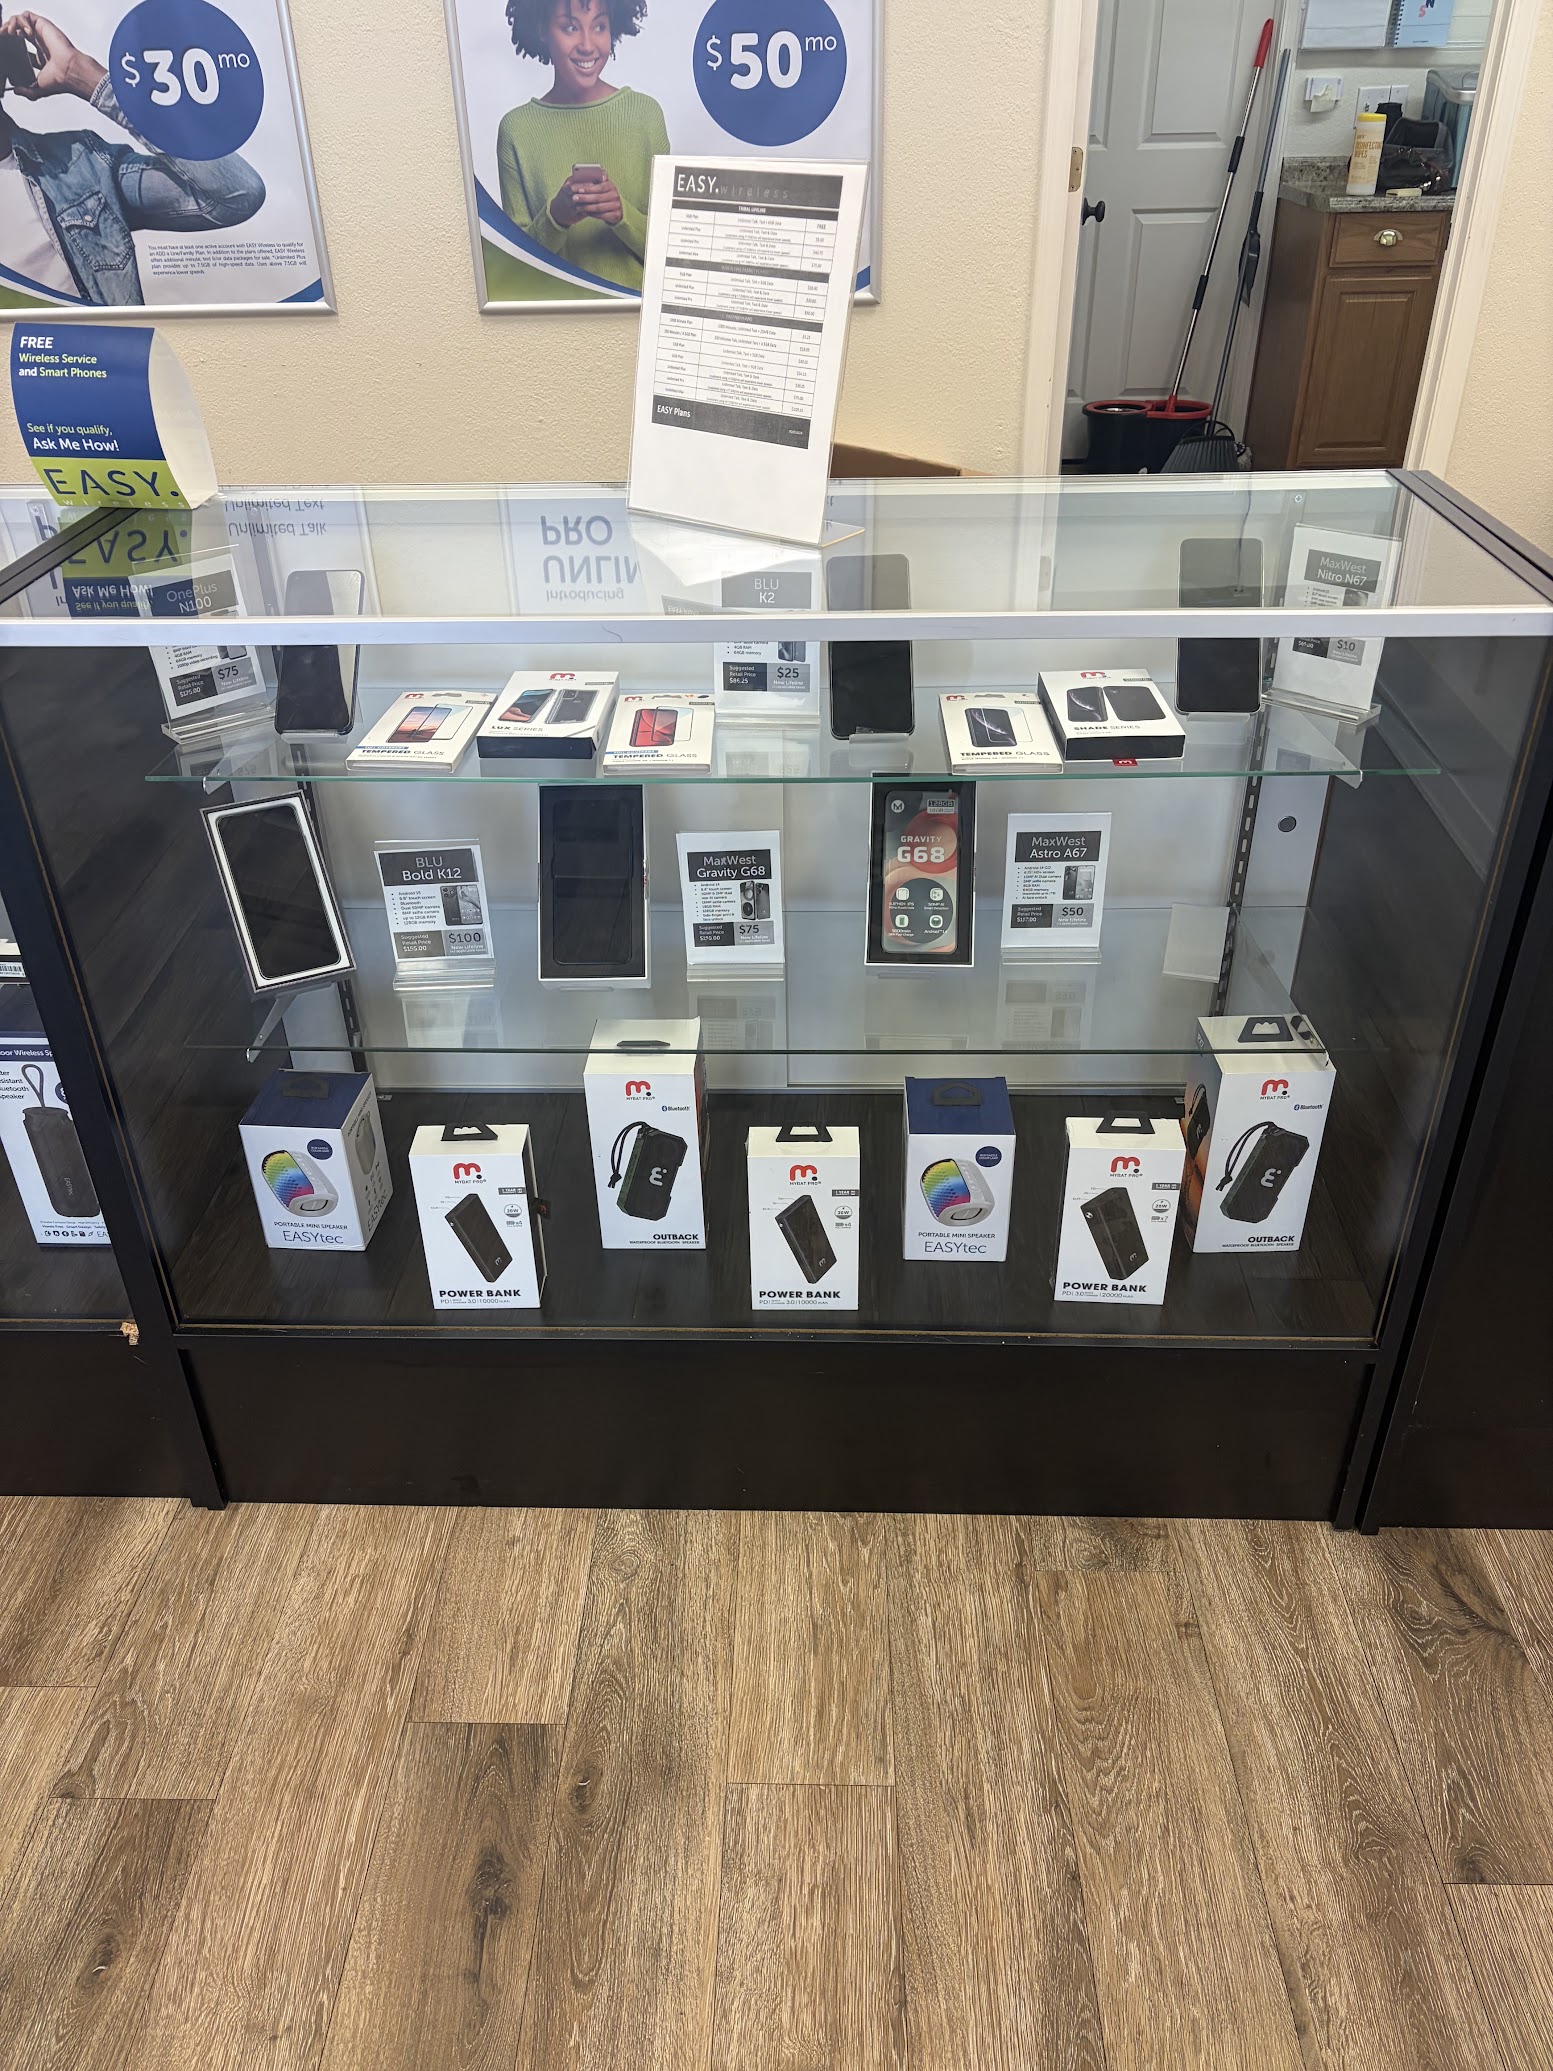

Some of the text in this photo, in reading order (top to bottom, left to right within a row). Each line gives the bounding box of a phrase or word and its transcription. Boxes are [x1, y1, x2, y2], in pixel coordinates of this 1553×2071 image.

[20, 336, 53, 348] FREE
[19, 353, 97, 364] Wireless Service
[19, 368, 107, 378] and Smart Phones
[657, 404, 691, 418] EASY Plans
[27, 423, 112, 435] See if you qualify,
[33, 438, 120, 451] Ask Me How!
[44, 469, 179, 497] EASY.
[1320, 556, 1367, 573] MaxWest
[1318, 569, 1367, 585] Nitro N67
[754, 578, 779, 590] BLU
[167, 582, 217, 602] OnePlus
[759, 593, 775, 603] K2
[178, 596, 212, 614] N100
[1337, 639, 1355, 651] $10
[218, 666, 238, 680] $75
[777, 666, 799, 679] $25
[1032, 837, 1085, 846] MaxWest
[897, 847, 945, 863] G68
[1030, 848, 1087, 858] Astro A67
[416, 857, 443, 868] BLU
[704, 856, 756, 866] MaxWest
[403, 868, 462, 881] Bold K12
[697, 867, 765, 879] Gravity G68
[1062, 907, 1083, 916] $50
[739, 924, 759, 934] $75
[449, 932, 481, 943] $100
[283, 1231, 343, 1244] EASYtec
[1248, 1235, 1295, 1243] OUTBACK
[924, 1241, 987, 1254] EASYtec
[1063, 1282, 1147, 1292] POWER BANK
